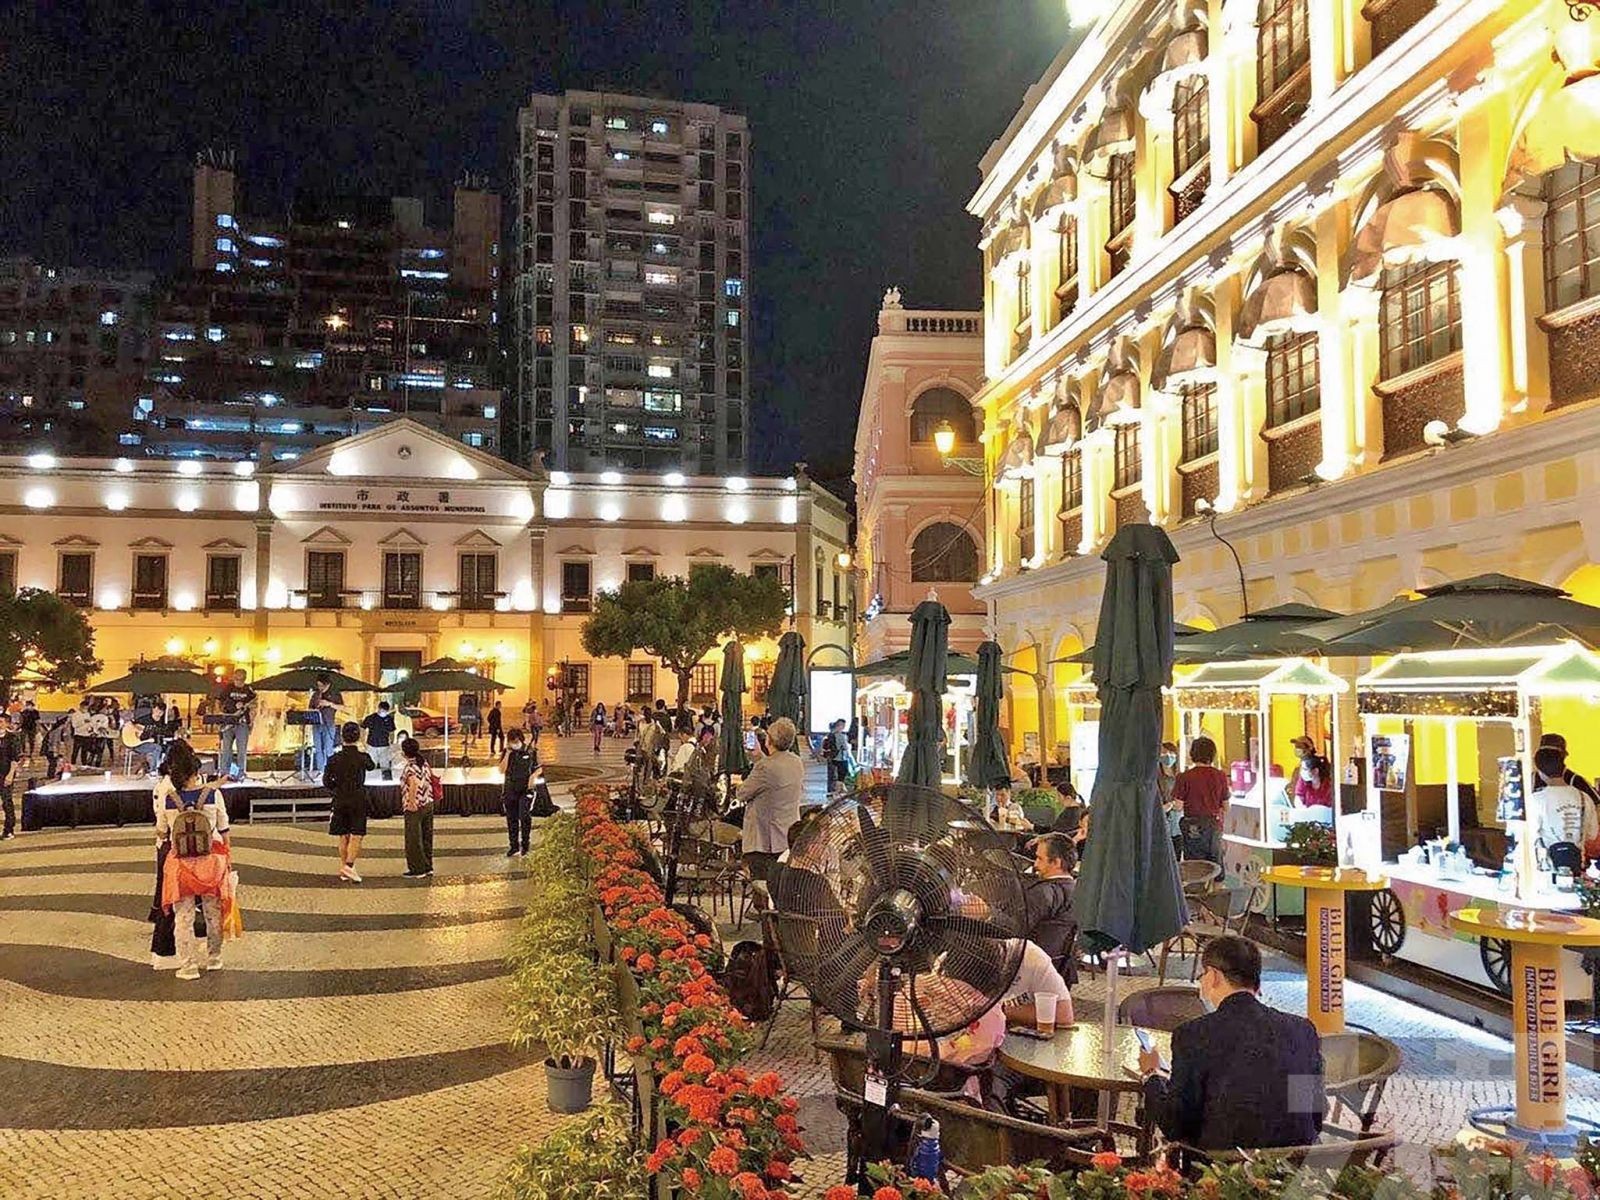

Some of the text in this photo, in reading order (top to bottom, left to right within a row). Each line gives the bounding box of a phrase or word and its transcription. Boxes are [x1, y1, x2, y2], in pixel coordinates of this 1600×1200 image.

[319, 502, 358, 510] INSTITUTO
[356, 489, 449, 503] 市政署
[1329, 908, 1343, 1013] BLUE GIRL
[1525, 968, 1538, 1100] IMPORTED PREMIUM BEER
[1538, 968, 1560, 1104] BLUE GIRL
